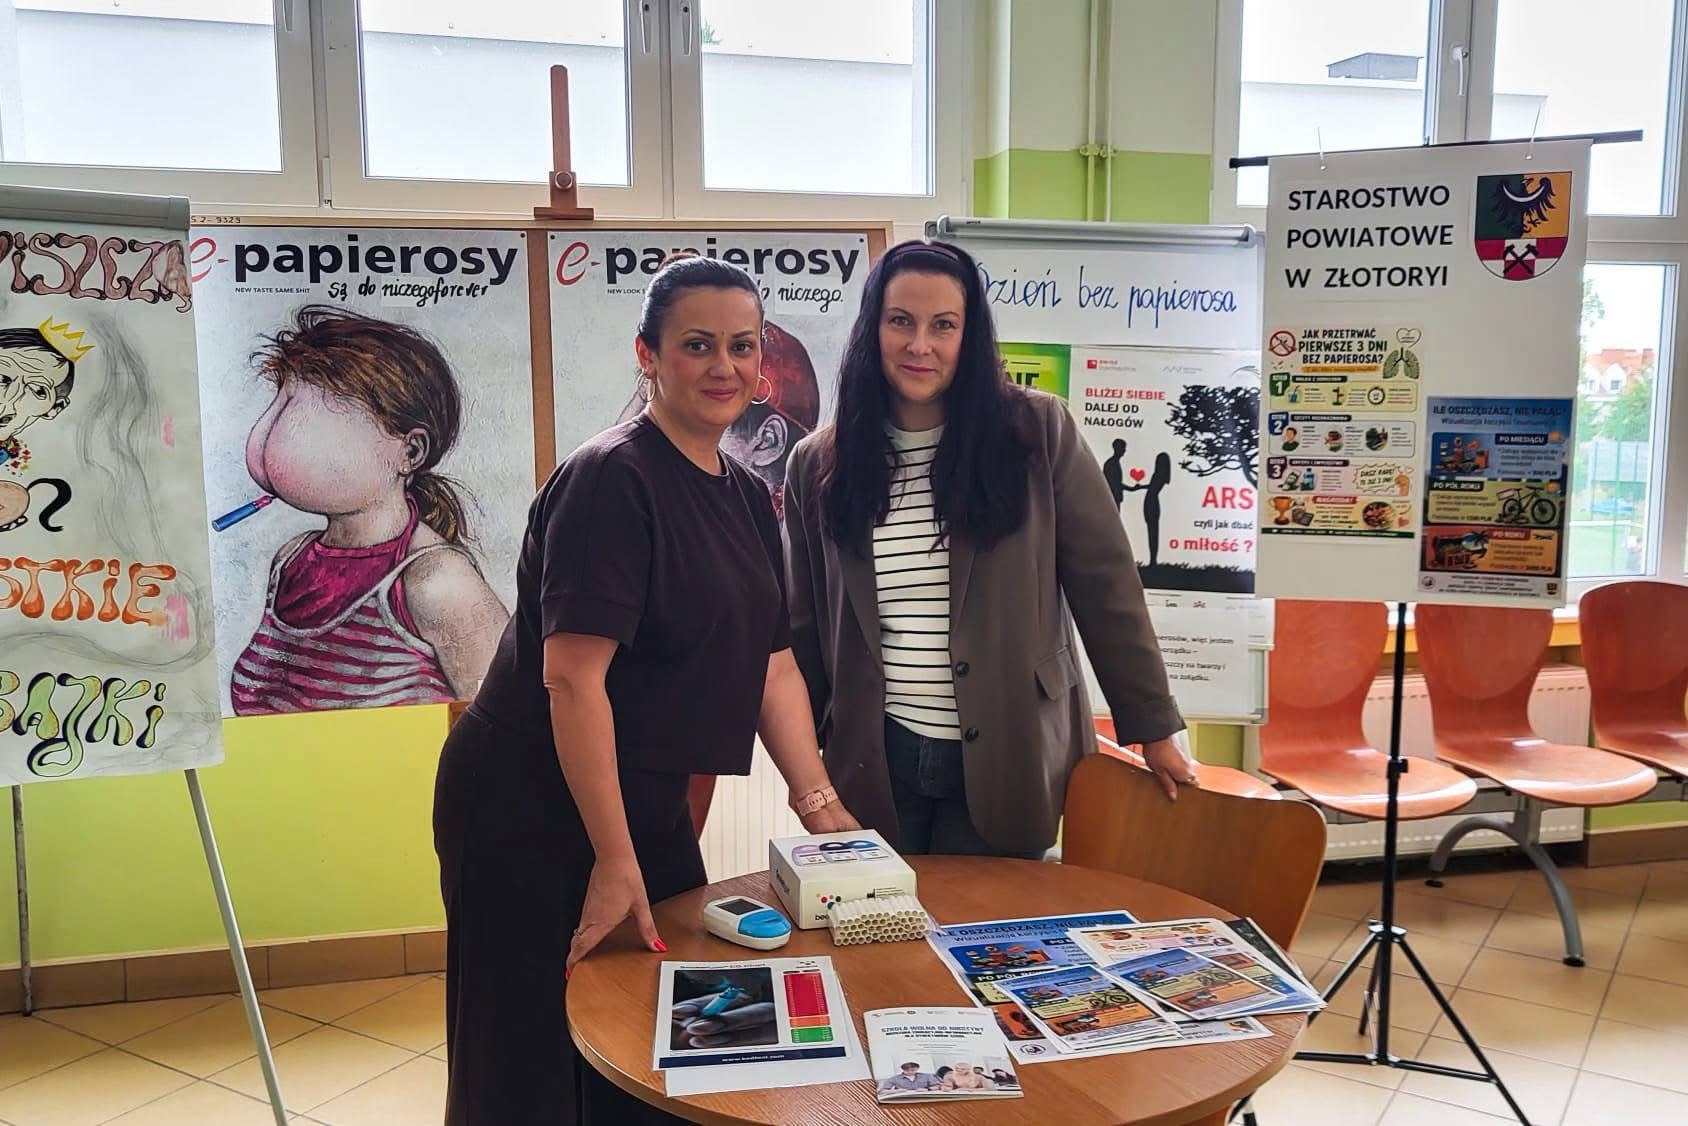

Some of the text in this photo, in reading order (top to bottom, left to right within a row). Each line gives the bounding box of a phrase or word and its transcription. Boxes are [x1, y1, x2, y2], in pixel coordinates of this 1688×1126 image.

[1288, 185, 1450, 211] STAROSTWO
[1286, 225, 1454, 249] POWIATOWE
[1285, 266, 1448, 288] W ZŁOTORYI
[358, 275, 377, 297] do
[1079, 265, 1119, 309] bez
[1128, 280, 1237, 328] papierosa
[1302, 327, 1376, 339] JAK PRZETRWAĆ
[1298, 341, 1388, 352] PIERWSZE 3 DNI
[1302, 354, 1384, 364] BEZ PAPIEROSA?
[1085, 387, 1166, 400] BLIŻEJ SIEBIE
[1276, 381, 1282, 394] 1
[1085, 402, 1139, 413] DALEJ OD
[1084, 416, 1144, 428] NAŁOGÓW
[1273, 420, 1282, 433] 2
[1272, 465, 1281, 477] 3
[1202, 486, 1254, 510] ARS
[1194, 520, 1253, 530] czyli jak dbać
[1169, 539, 1179, 549] o
[1184, 537, 1239, 552] miłość
